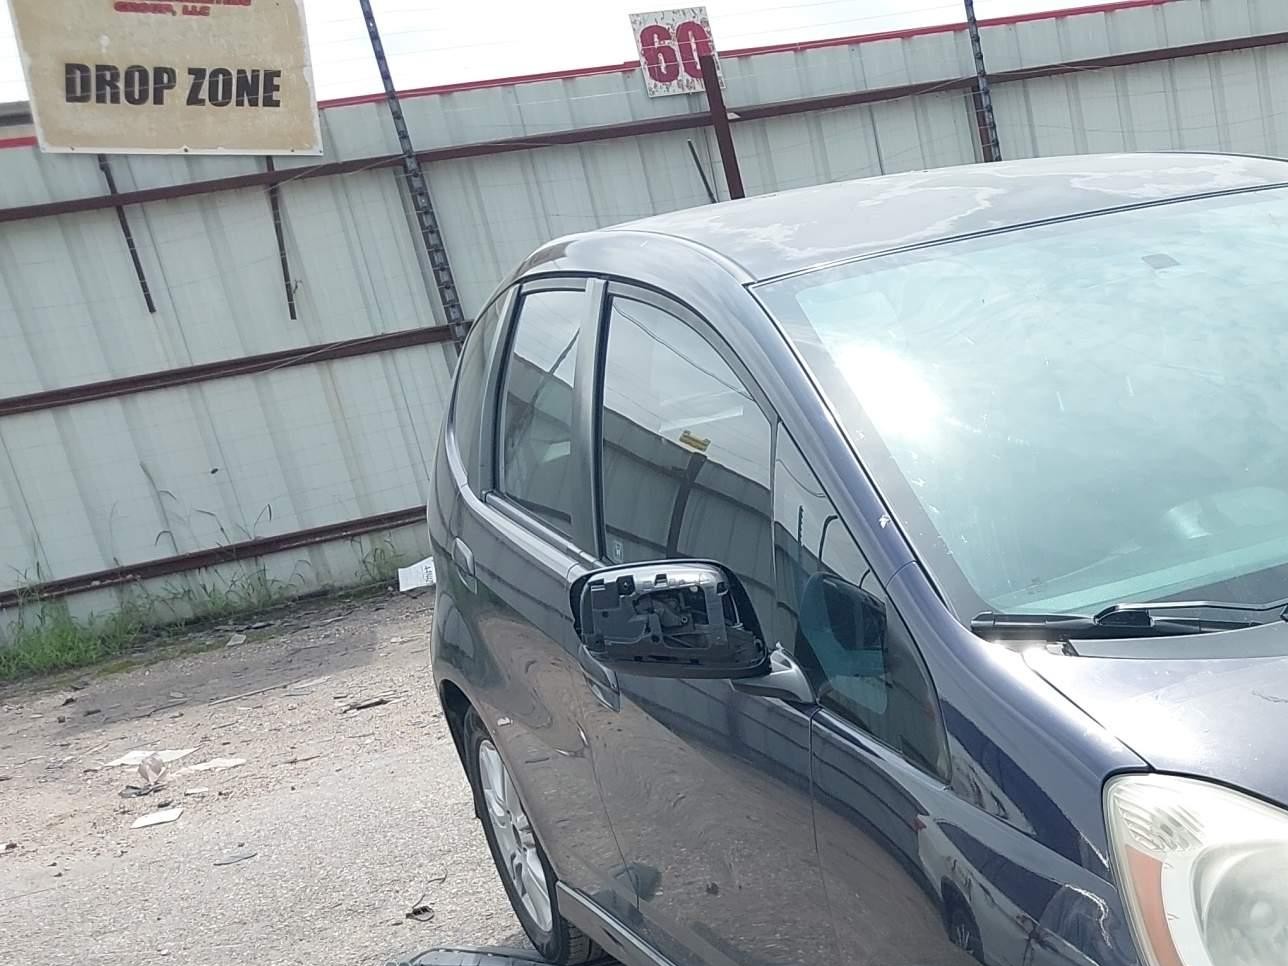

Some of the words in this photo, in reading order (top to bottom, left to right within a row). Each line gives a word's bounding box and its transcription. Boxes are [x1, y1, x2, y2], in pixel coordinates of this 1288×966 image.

[640, 21, 712, 83] 60
[65, 63, 177, 106] DROP
[186, 67, 282, 107] ZONE
